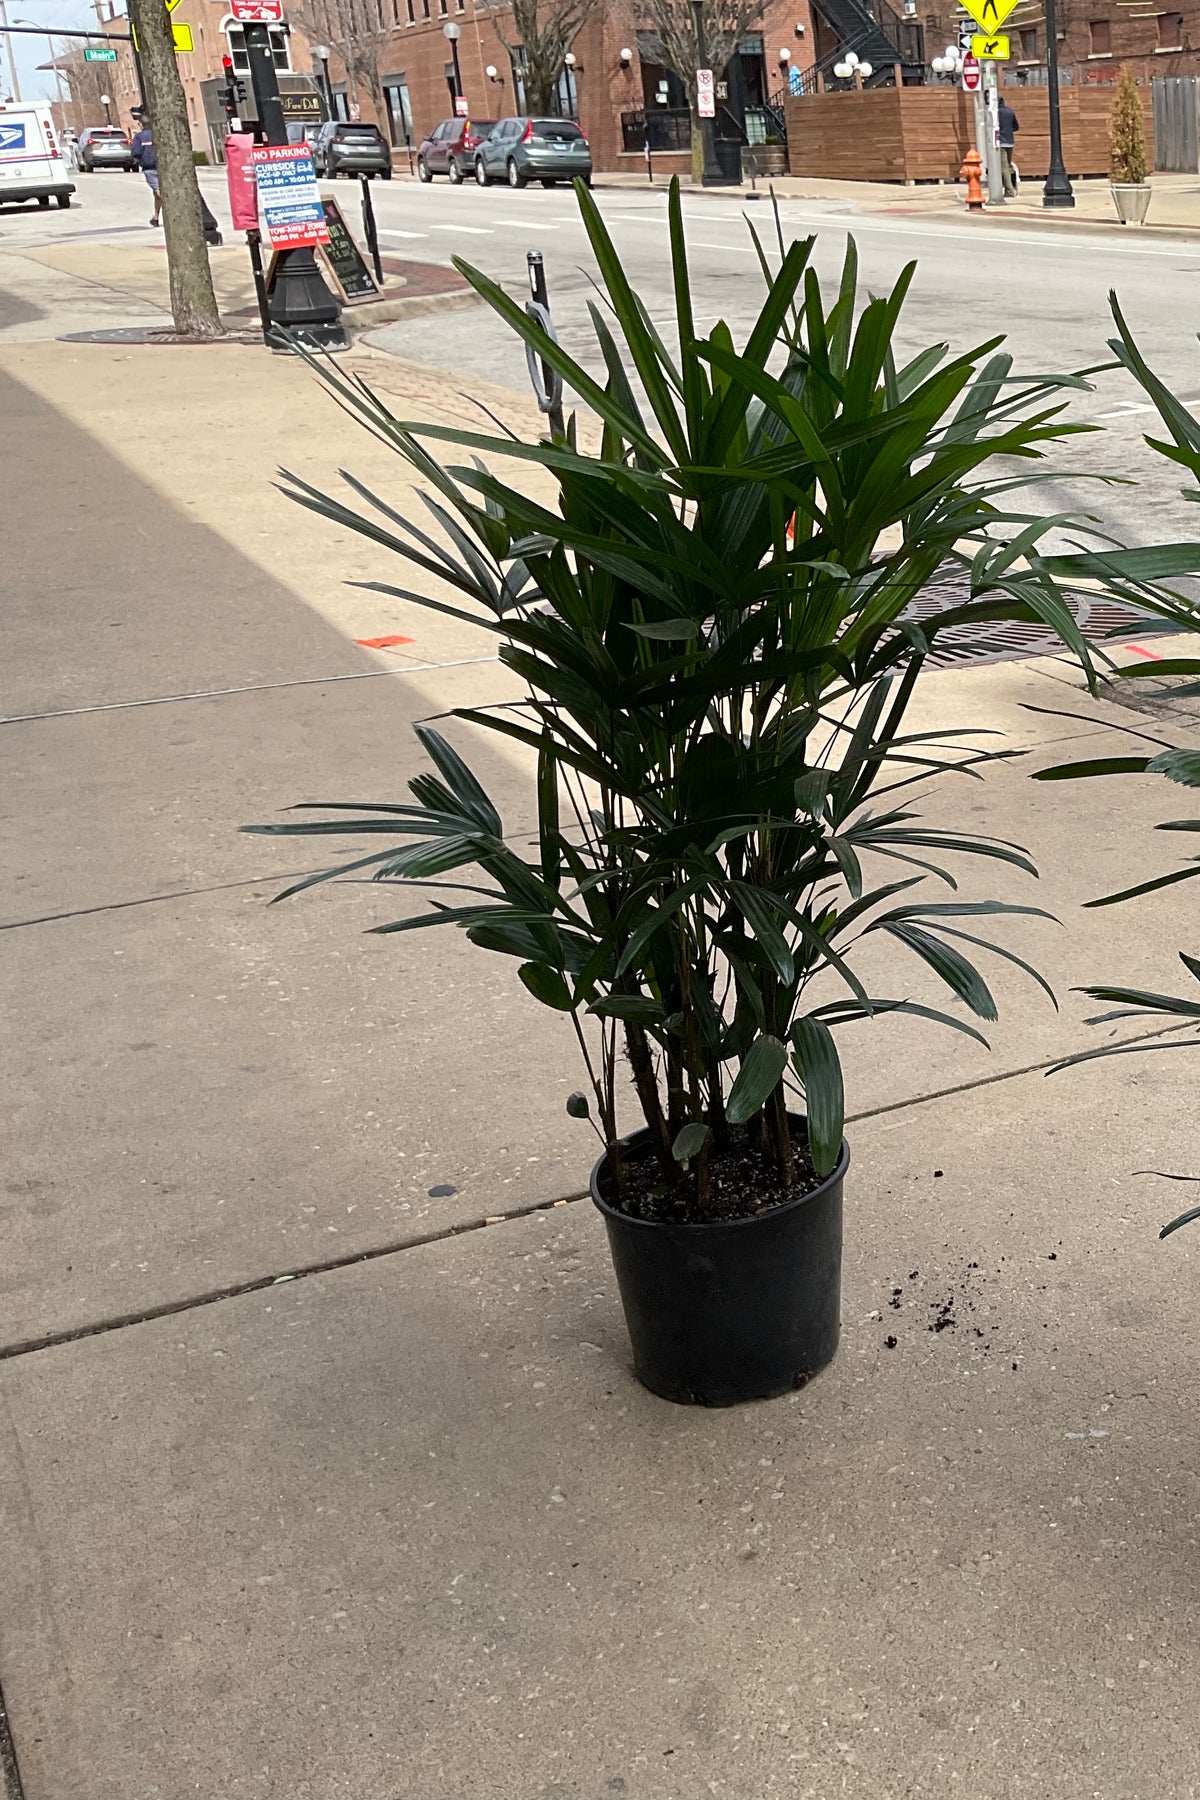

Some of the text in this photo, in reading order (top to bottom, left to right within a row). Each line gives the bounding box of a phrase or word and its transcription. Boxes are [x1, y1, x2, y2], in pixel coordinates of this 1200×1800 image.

[253, 146, 311, 160] NO PARKING
[255, 162, 296, 173] CURBSIDE
[270, 223, 306, 236] TOW-AWAY
[307, 221, 326, 231] ZONE
